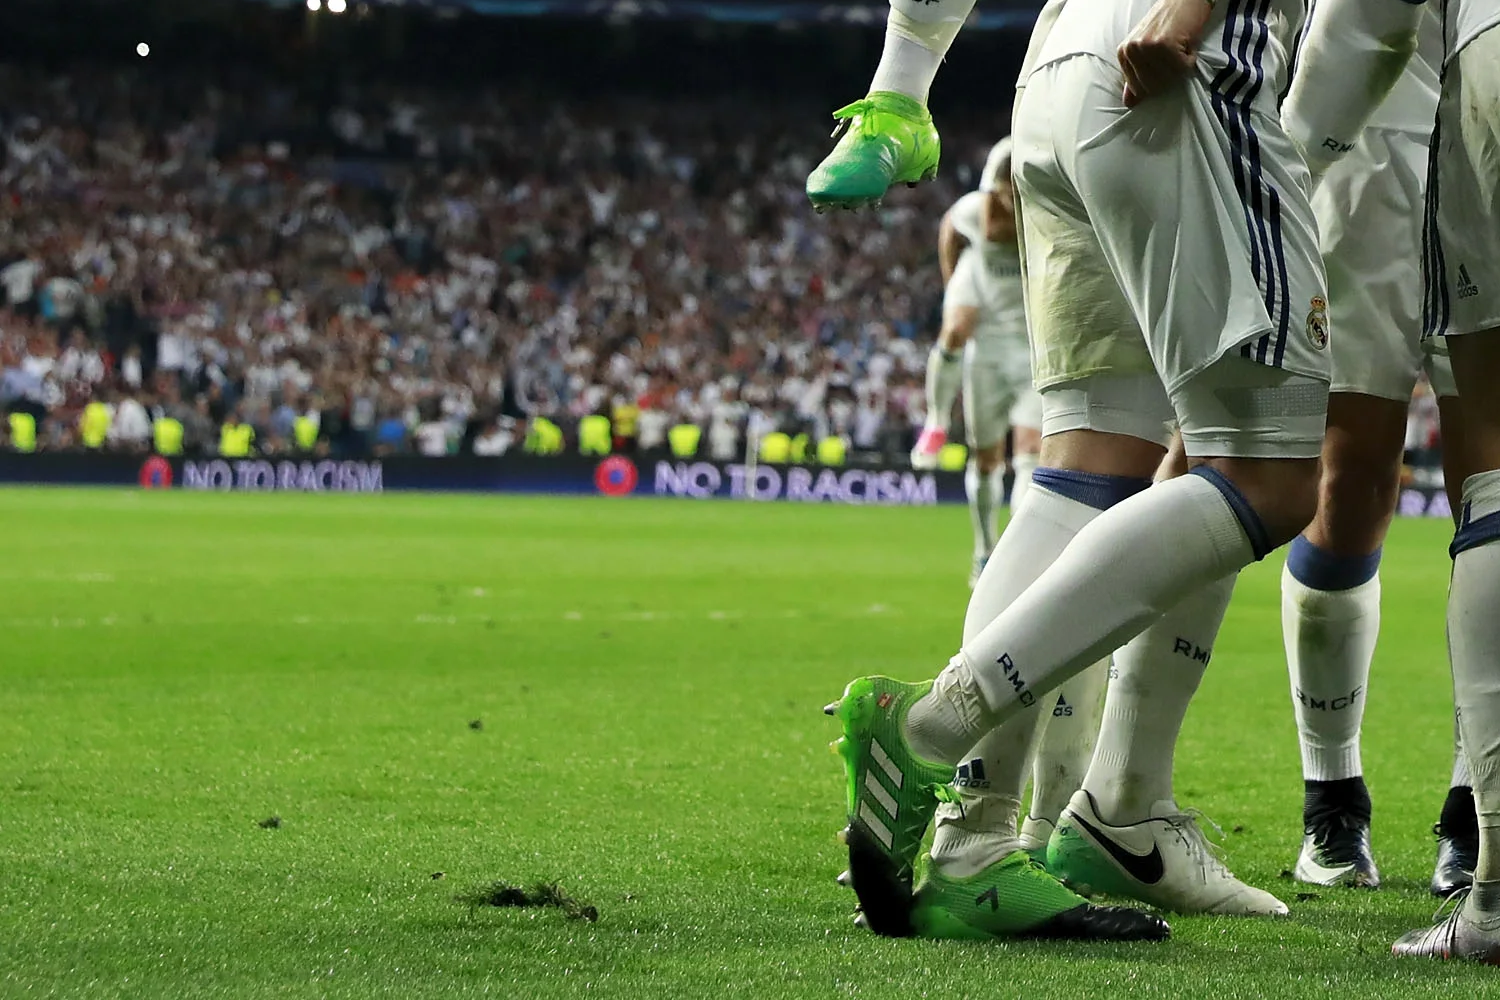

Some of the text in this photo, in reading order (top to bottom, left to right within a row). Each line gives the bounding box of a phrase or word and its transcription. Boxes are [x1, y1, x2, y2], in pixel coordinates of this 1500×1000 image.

[183, 460, 384, 493] NO TO RACISM
[655, 461, 937, 506] NO TO RACISM
[1296, 686, 1362, 712] RMCF
